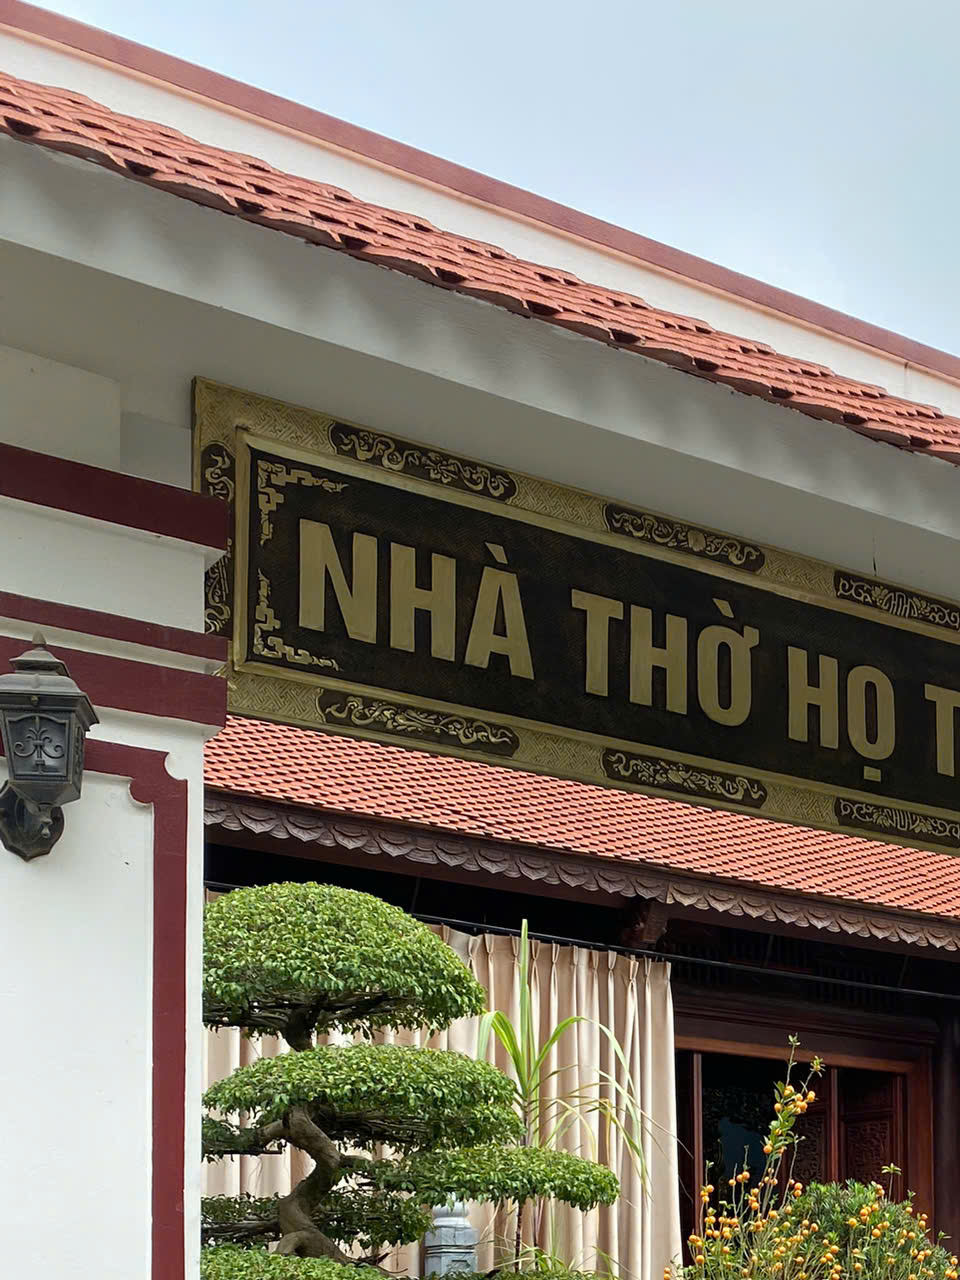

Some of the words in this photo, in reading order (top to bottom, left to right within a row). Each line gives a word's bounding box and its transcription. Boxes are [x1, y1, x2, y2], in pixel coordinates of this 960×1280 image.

[299, 519, 533, 680] NHÀ
[571, 588, 759, 727] THỜ
[787, 647, 896, 782] HỌ
